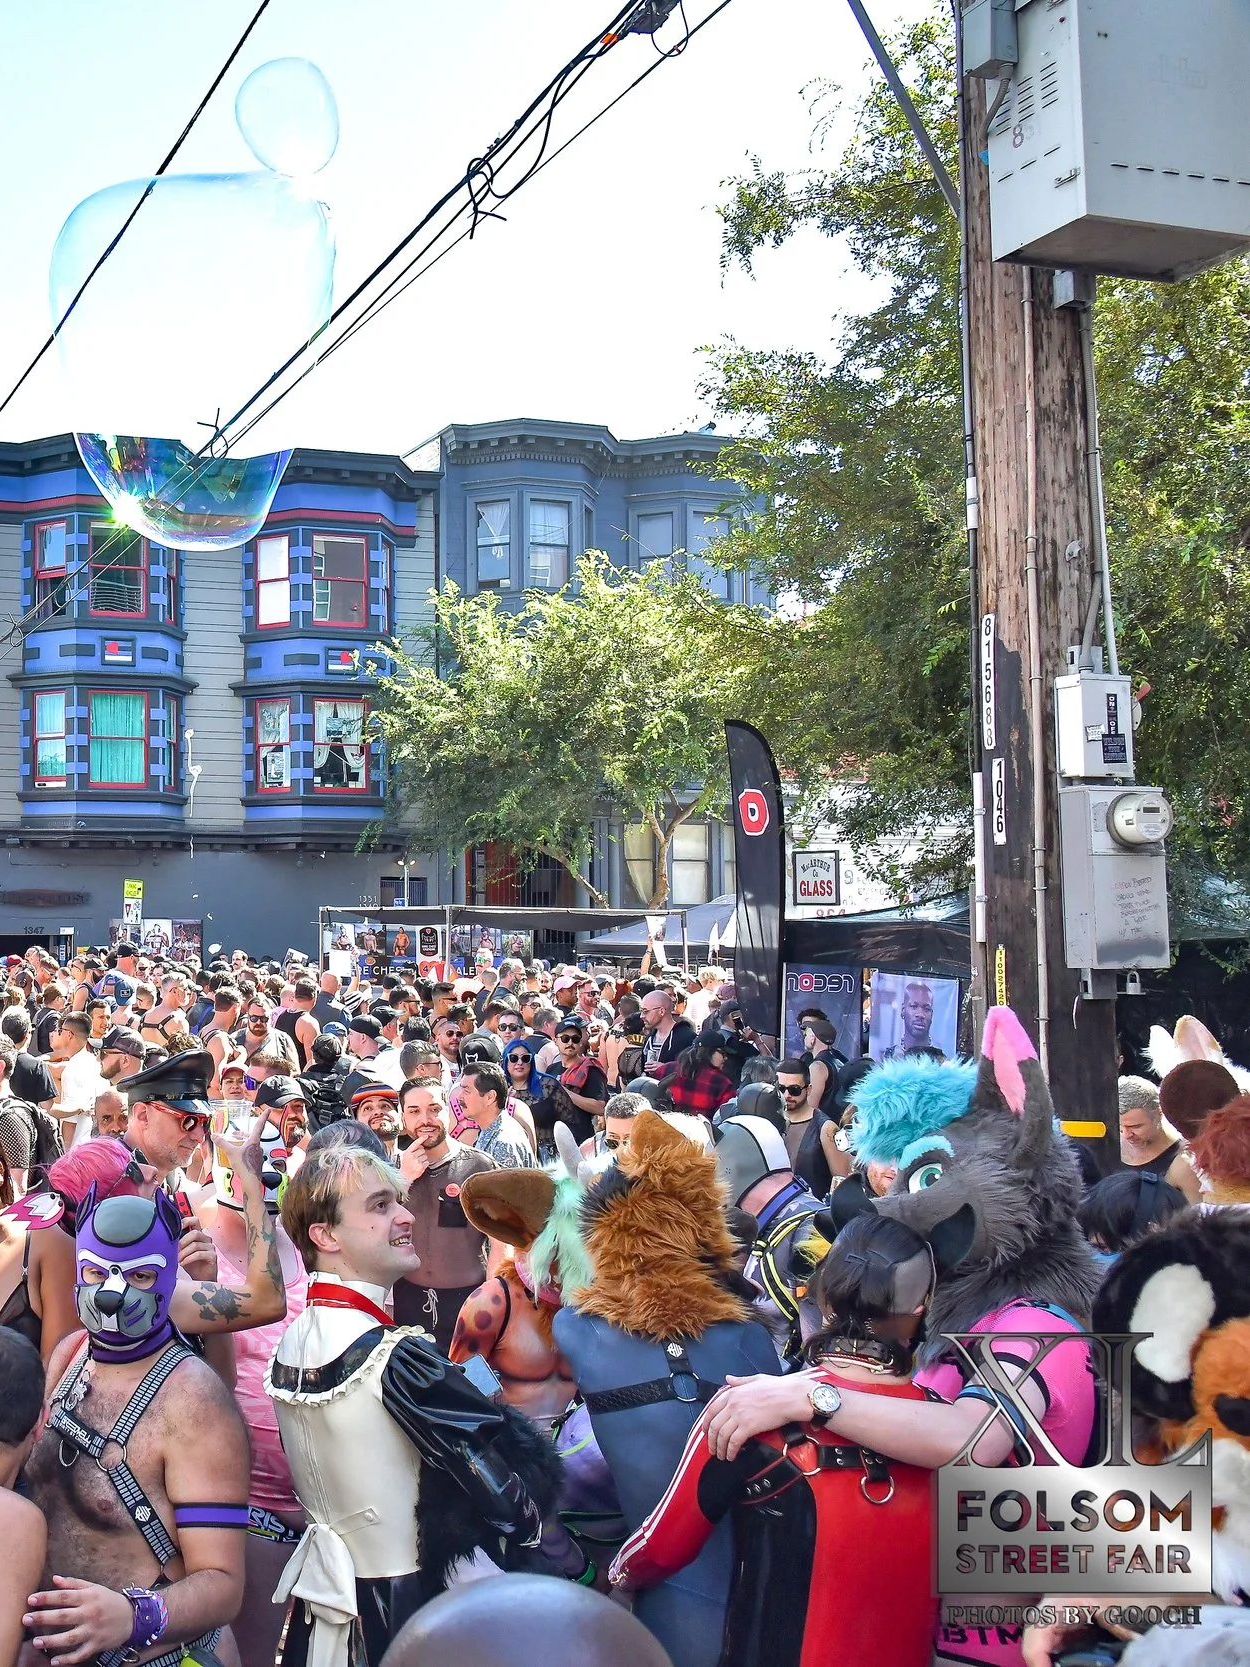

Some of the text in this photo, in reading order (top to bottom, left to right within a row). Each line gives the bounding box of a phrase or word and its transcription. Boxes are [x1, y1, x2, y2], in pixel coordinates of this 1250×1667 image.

[984, 618, 993, 747] 815688
[996, 760, 1004, 833] 1046
[799, 879, 833, 897] GLASS
[23, 926, 45, 934] 1347
[372, 966, 403, 975] CHES
